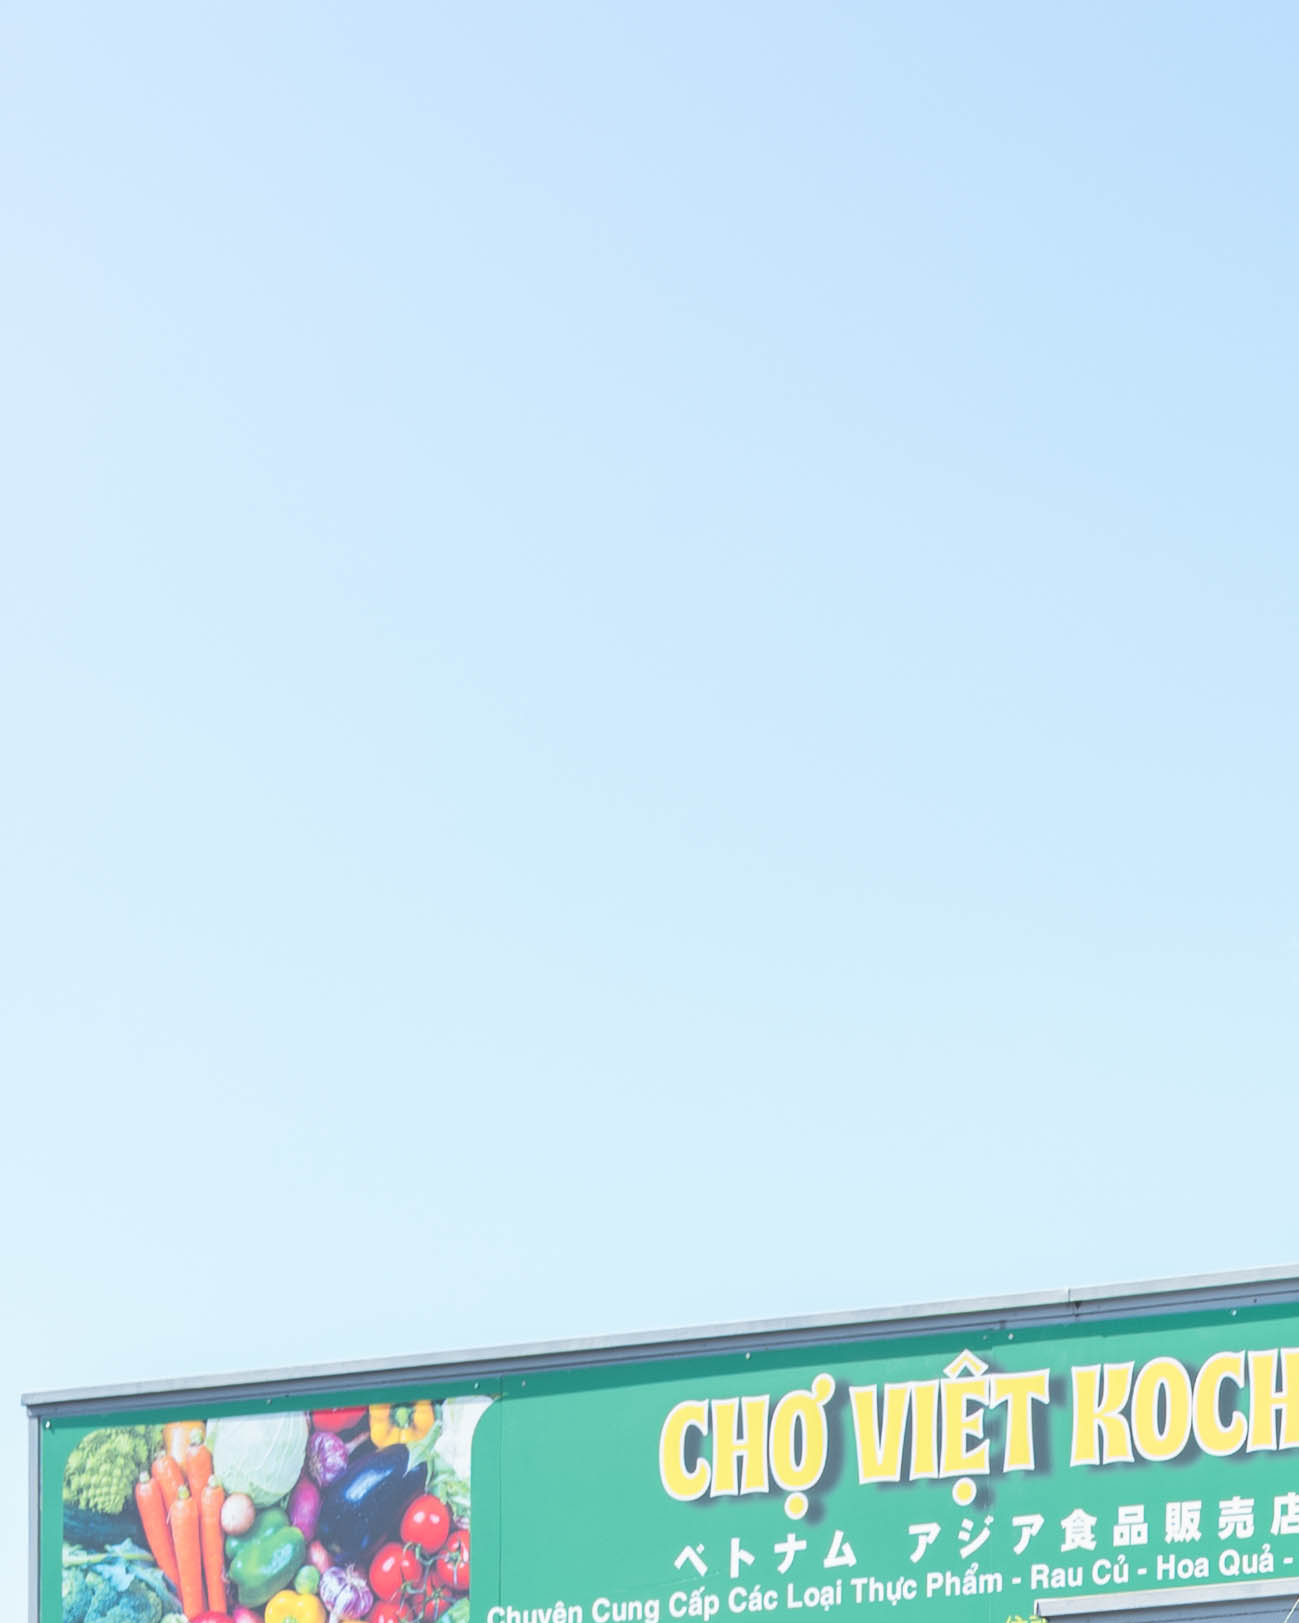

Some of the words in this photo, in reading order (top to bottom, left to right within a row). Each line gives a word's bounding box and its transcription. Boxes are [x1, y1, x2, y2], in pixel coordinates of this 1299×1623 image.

[659, 1373, 836, 1520] CHỢ
[849, 1349, 1050, 1507] VIỆT
[669, 1588, 719, 1621] Cấp
[729, 1584, 777, 1614] Các
[787, 1577, 842, 1612] Loại
[850, 1577, 917, 1607] Thực
[926, 1562, 1002, 1598] Phẩm
[1030, 1563, 1083, 1590] Rau
[1092, 1554, 1129, 1585] Củ
[1157, 1553, 1209, 1580] Hoa
[1219, 1545, 1273, 1577] Quả
[674, 1530, 857, 1578] ベトナム
